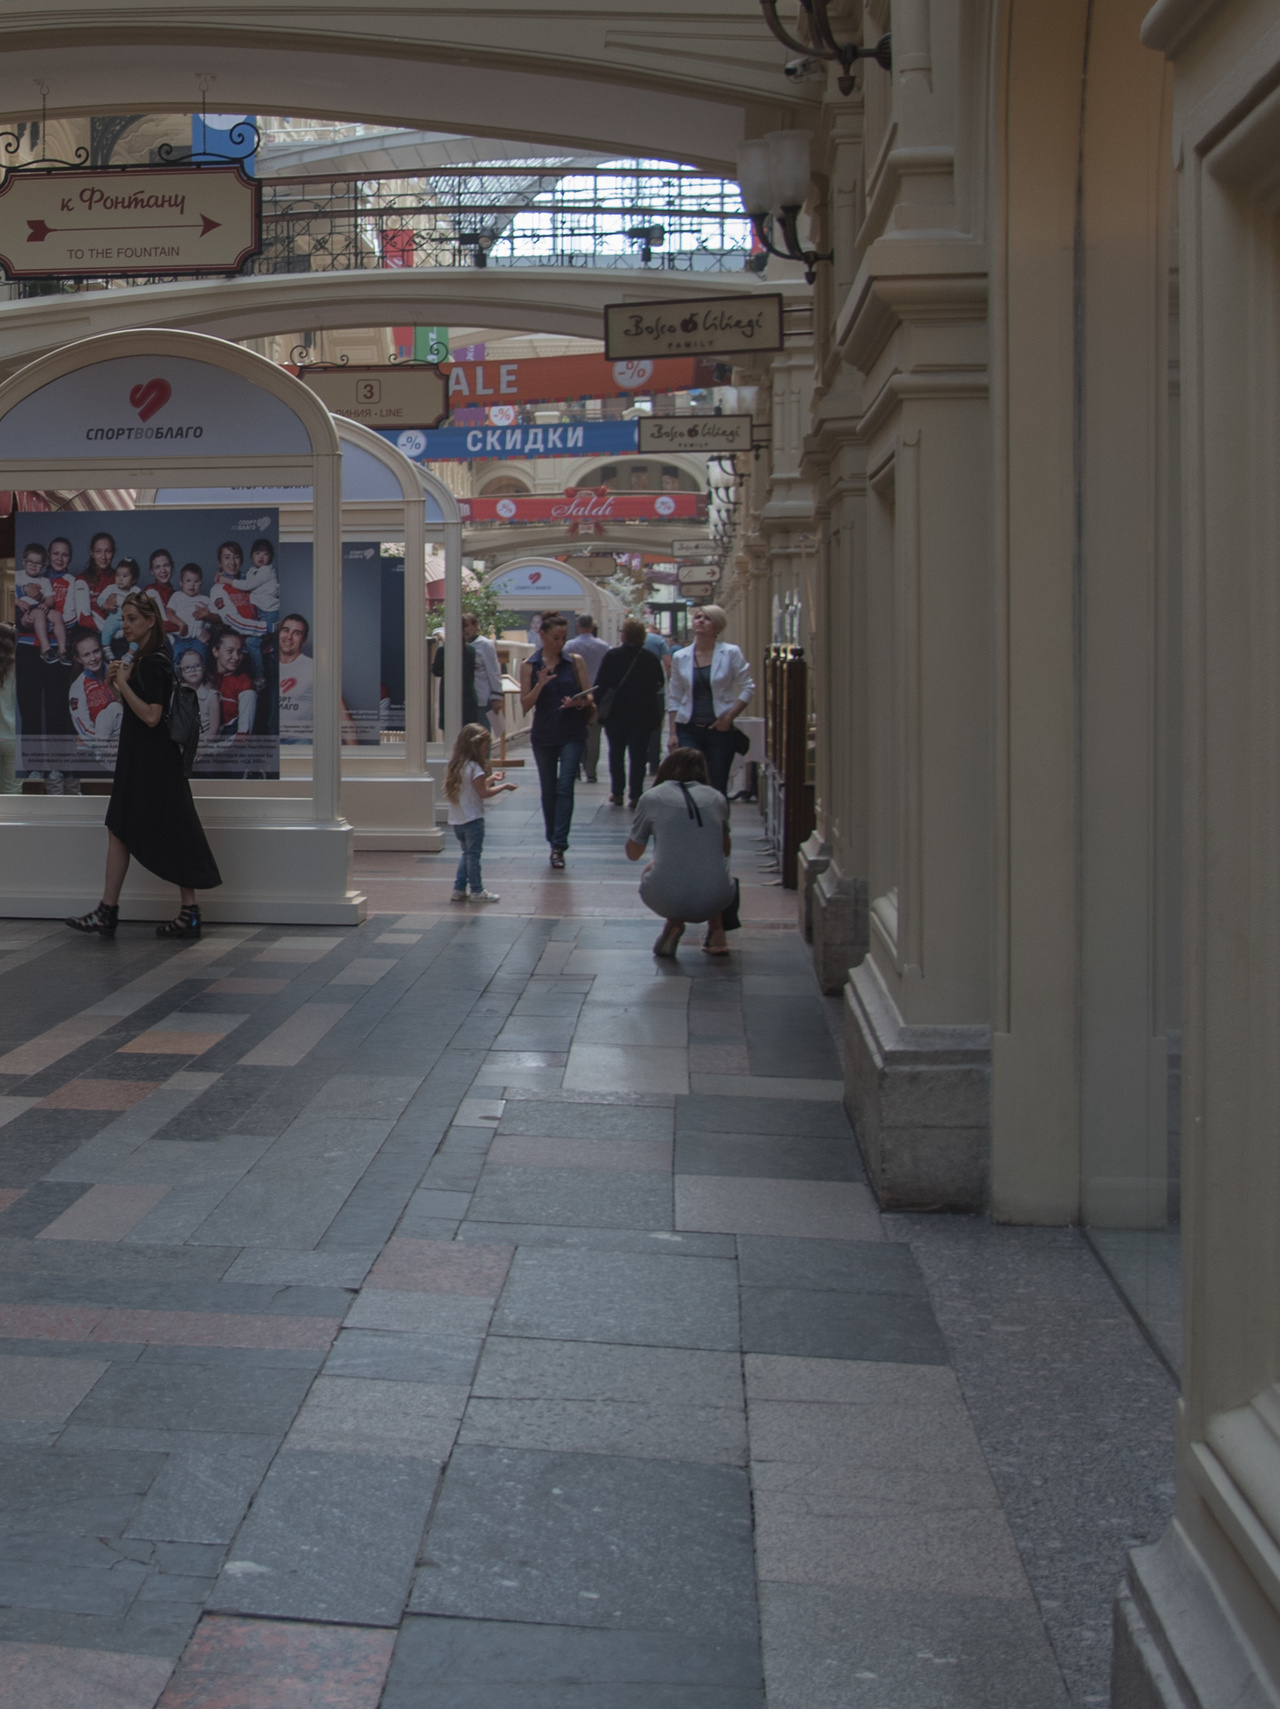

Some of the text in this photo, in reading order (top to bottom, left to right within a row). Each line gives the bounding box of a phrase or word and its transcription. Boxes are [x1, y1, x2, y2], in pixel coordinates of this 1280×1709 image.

[79, 187, 185, 215] Фонтану
[67, 246, 180, 260] TO THE FOUNTAIN
[668, 340, 714, 349] FAMILY
[449, 364, 518, 396] ALE
[363, 384, 374, 399] 3
[380, 408, 403, 418] LINE
[85, 425, 203, 442] СПОРТВОБЛАГО
[466, 425, 584, 454] СКИДКИ
[551, 496, 616, 518] Saldi
